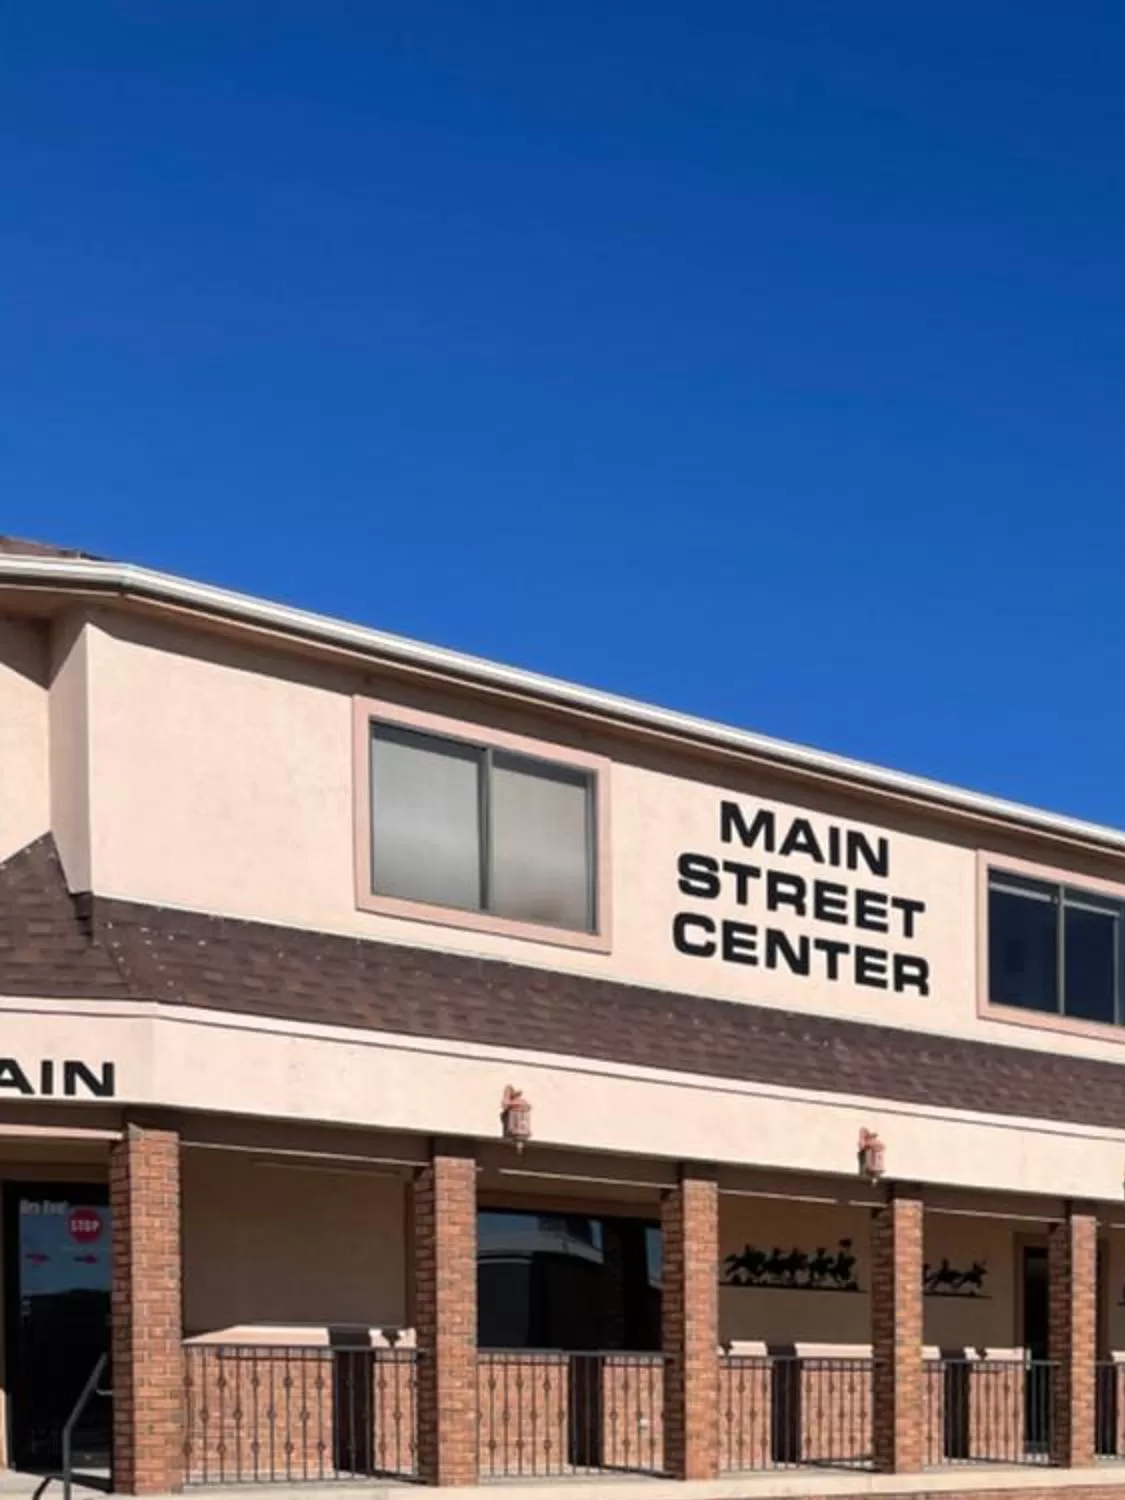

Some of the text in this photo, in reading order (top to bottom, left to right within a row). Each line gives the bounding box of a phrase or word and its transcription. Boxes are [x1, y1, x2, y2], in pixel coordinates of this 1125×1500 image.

[720, 800, 889, 878] MAIN
[677, 852, 926, 939] STREET
[672, 912, 930, 997] CENTER
[70, 1219, 100, 1233] STOP
